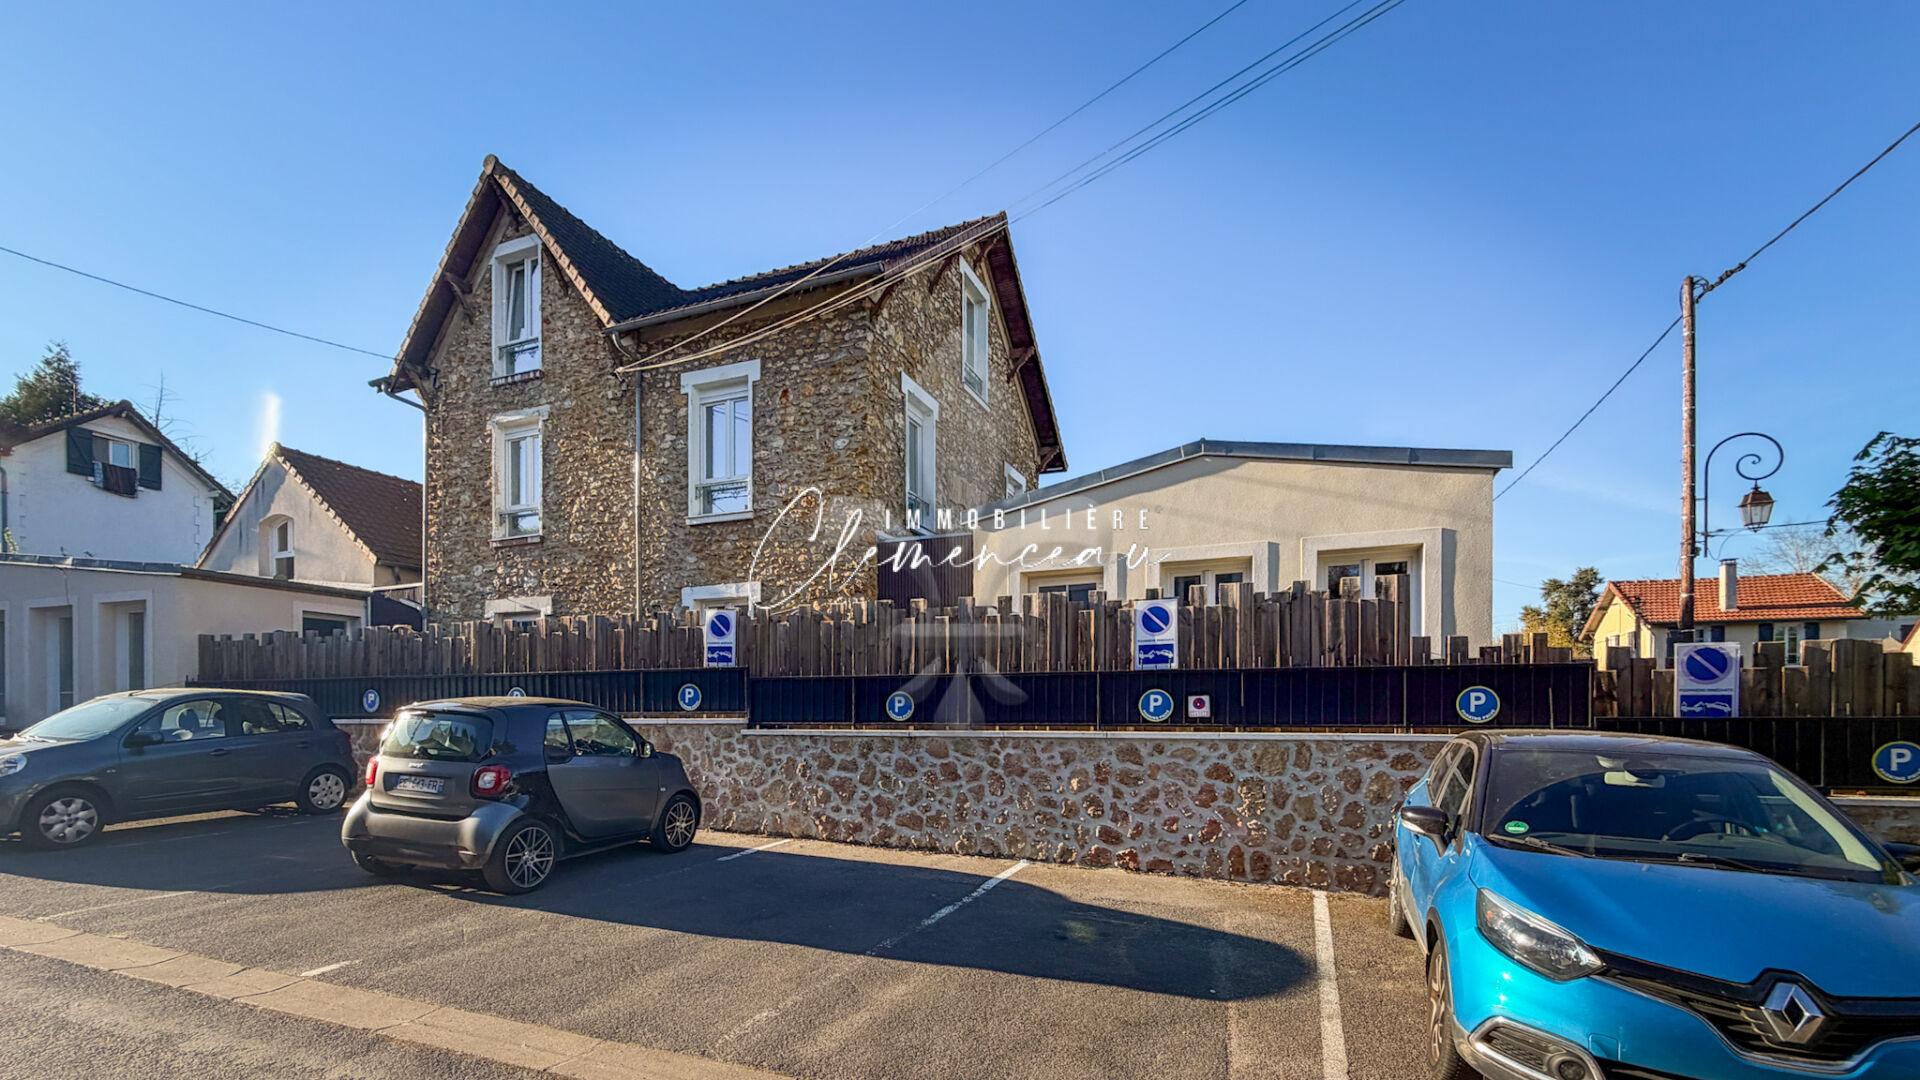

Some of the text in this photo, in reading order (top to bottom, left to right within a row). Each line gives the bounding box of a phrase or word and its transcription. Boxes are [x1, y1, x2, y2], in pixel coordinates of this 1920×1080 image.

[368, 693, 375, 704] P
[685, 688, 694, 703] P
[894, 696, 905, 713] P
[1149, 694, 1163, 713] P
[1470, 692, 1487, 713] P
[1890, 748, 1912, 771] P
